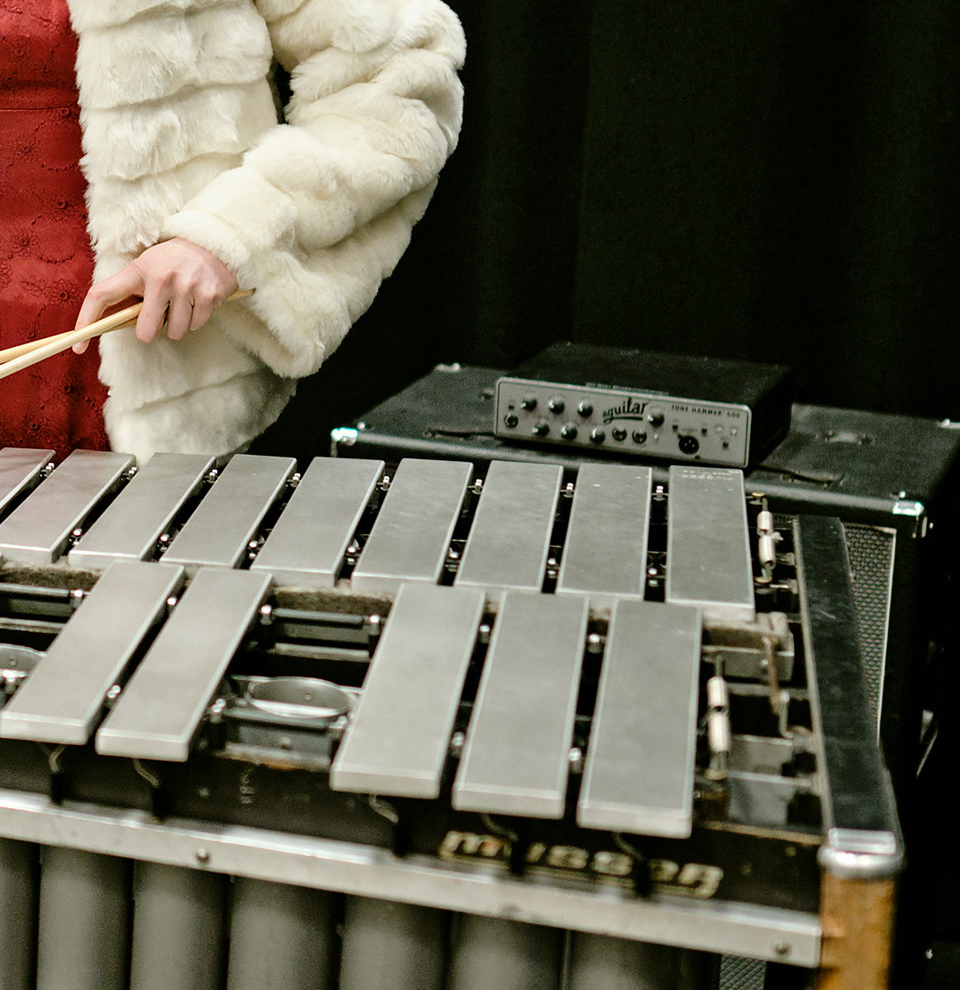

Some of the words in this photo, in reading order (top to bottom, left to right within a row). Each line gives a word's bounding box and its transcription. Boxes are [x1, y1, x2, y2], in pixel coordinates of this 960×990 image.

[602, 396, 650, 425] aguilar
[671, 404, 689, 413] TONE
[691, 407, 722, 417] HAMMER
[727, 411, 741, 419] 500
